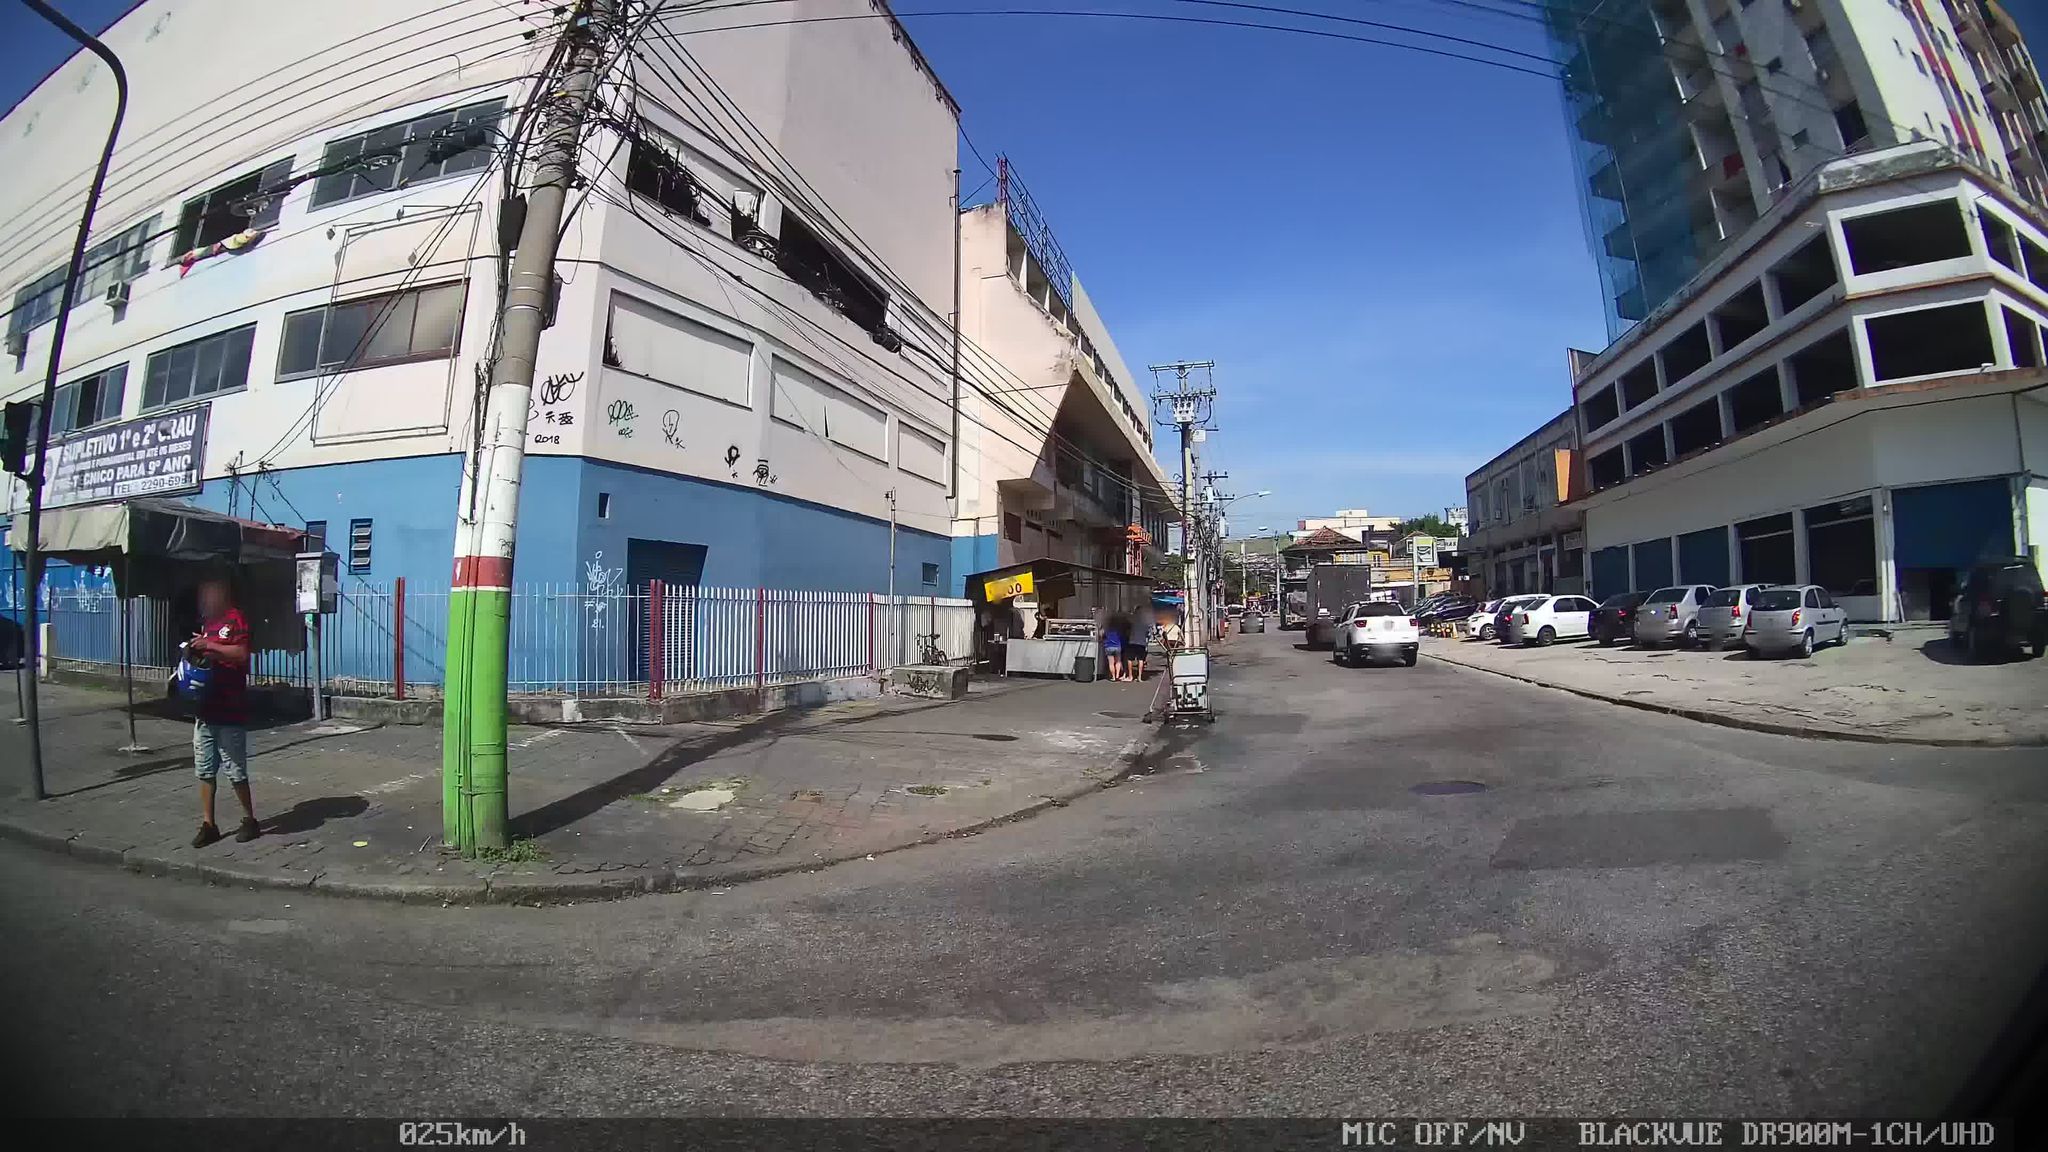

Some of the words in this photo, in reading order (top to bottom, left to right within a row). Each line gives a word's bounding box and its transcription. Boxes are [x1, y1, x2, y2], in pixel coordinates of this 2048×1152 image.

[63, 433, 117, 463] SUPLETIVO
[73, 468, 114, 488] TCNICO
[116, 463, 146, 480] PARA
